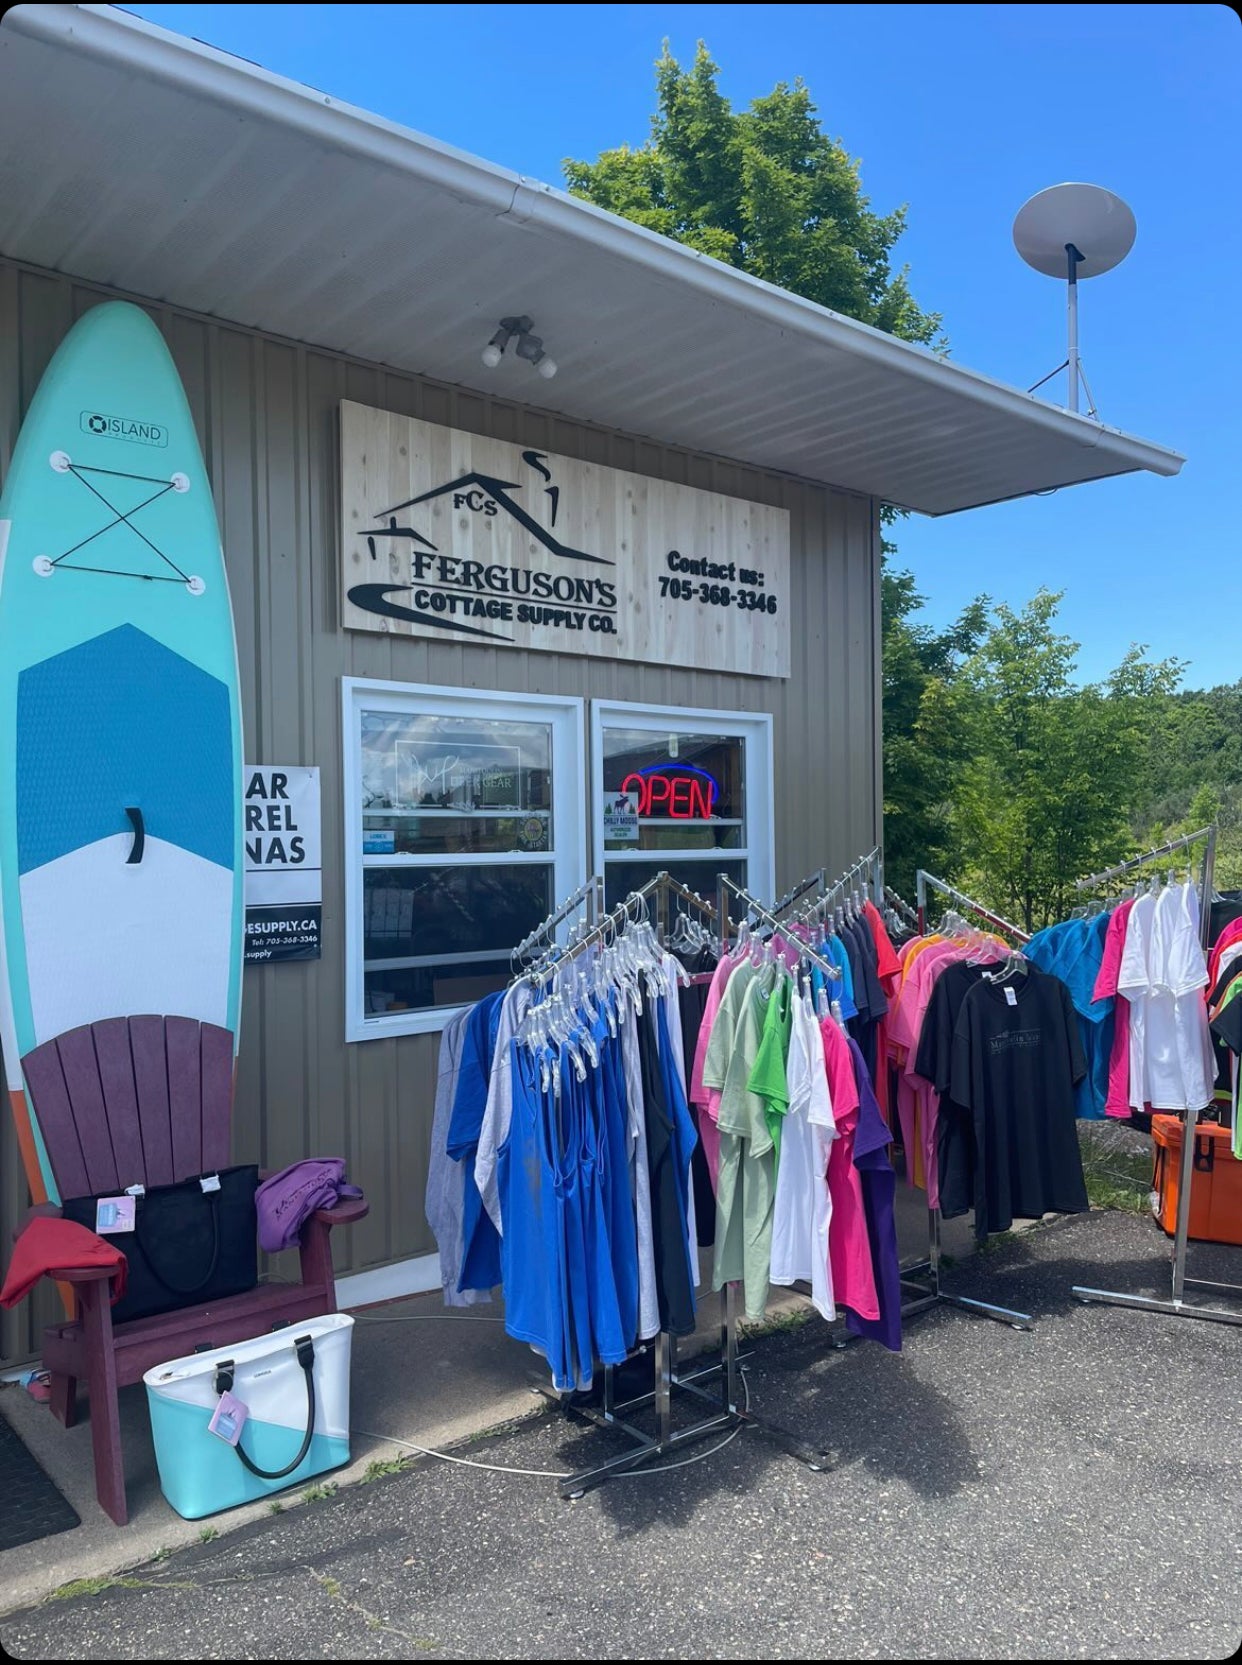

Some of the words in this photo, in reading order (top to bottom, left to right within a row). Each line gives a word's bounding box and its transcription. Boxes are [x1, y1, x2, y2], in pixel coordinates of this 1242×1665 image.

[108, 418, 161, 440] ISLAND
[453, 489, 499, 517] FCS
[412, 550, 618, 609] FERGUSON'S
[667, 550, 736, 582] Contact
[738, 567, 765, 587] us:
[658, 576, 778, 615] 705-368-3346
[414, 590, 513, 621] COTTAGE
[517, 603, 587, 631] SUPPLY
[588, 612, 617, 635] CO.
[245, 772, 290, 800] AR
[482, 776, 512, 788] GEAR
[621, 773, 713, 820] OPEN
[245, 804, 298, 832] REL
[620, 817, 638, 825] MOOSE
[265, 935, 318, 945] 705-368-3346
